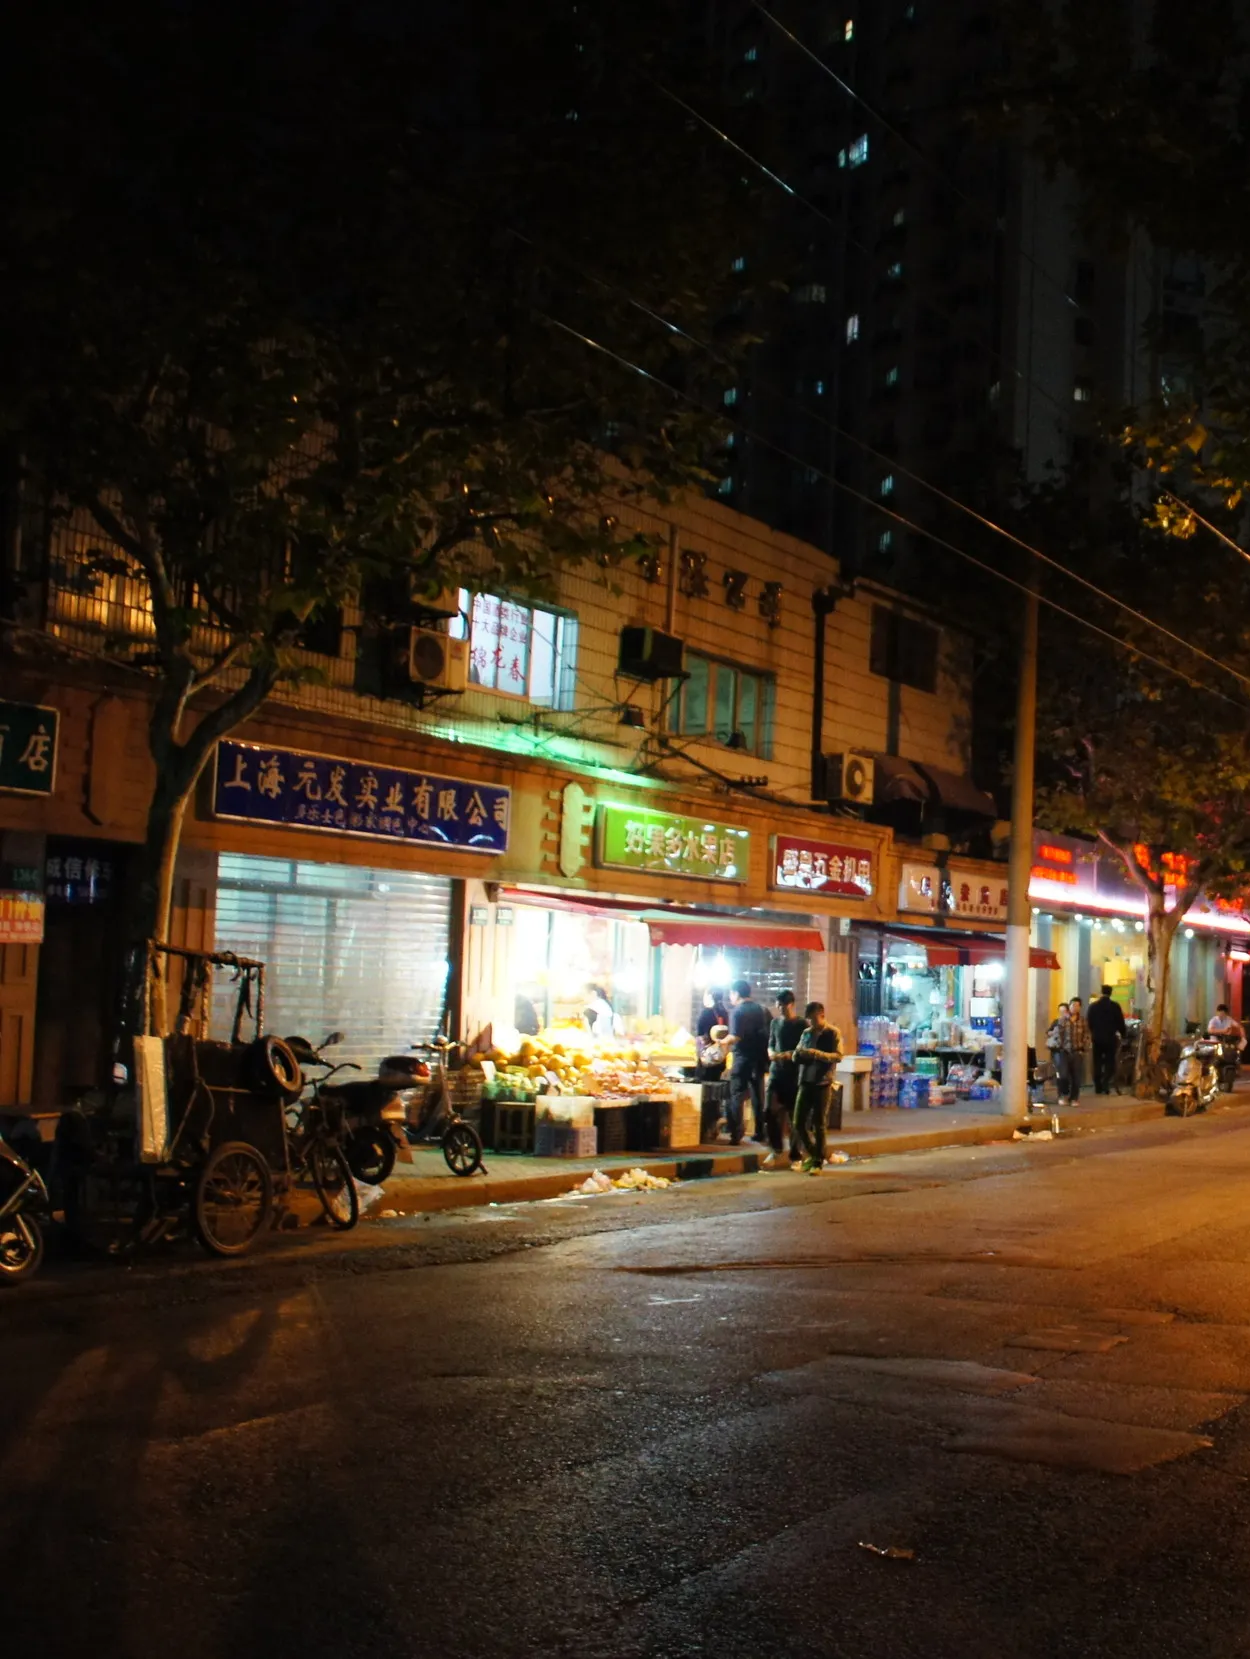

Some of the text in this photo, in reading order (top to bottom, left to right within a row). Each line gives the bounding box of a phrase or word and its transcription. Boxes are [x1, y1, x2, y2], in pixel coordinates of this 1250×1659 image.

[223, 753, 508, 831] 上海元发实业有限公司
